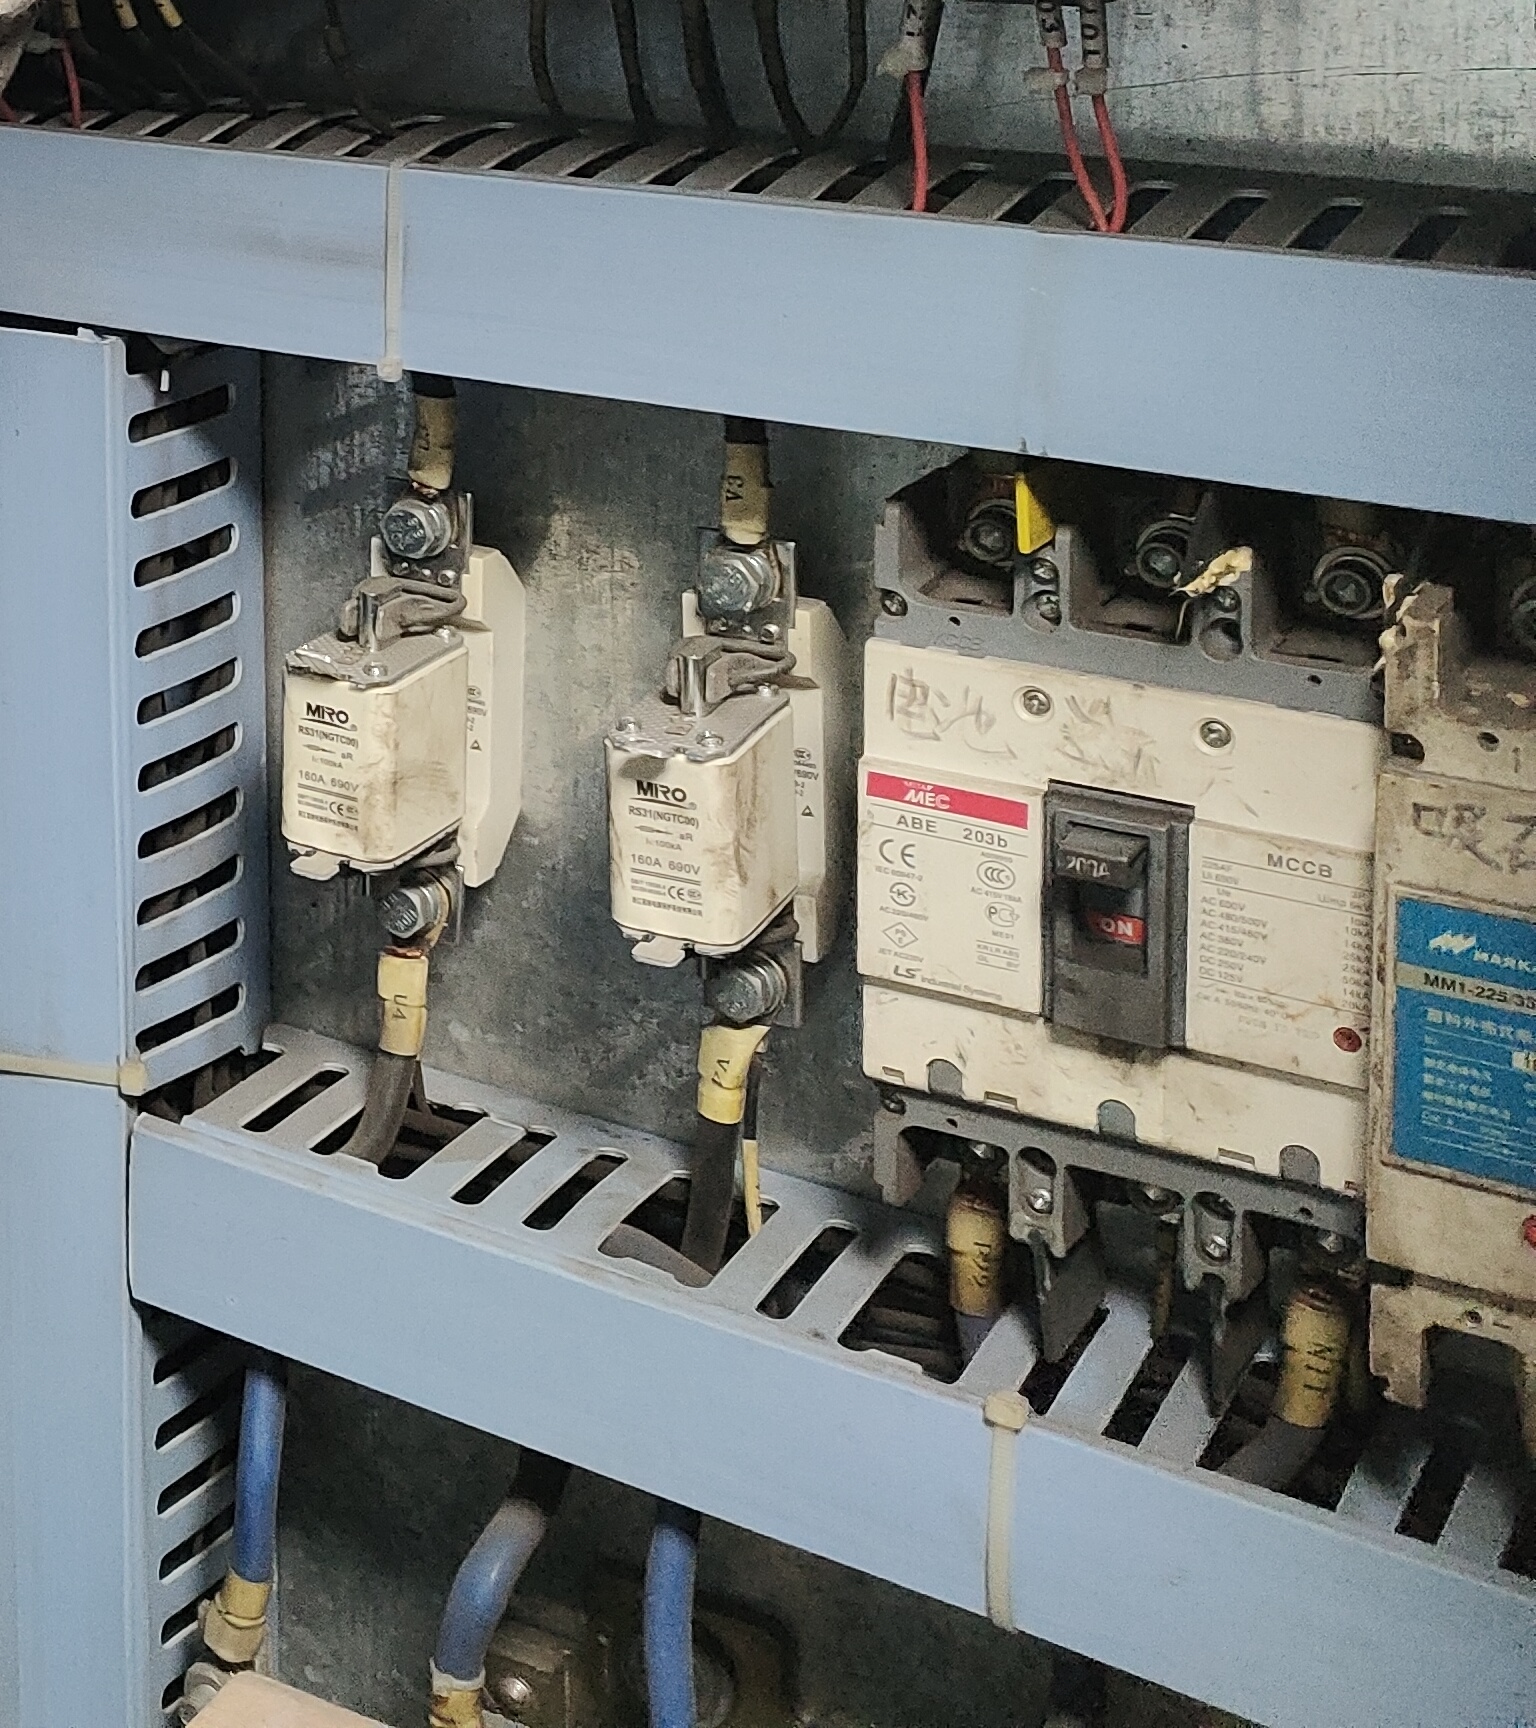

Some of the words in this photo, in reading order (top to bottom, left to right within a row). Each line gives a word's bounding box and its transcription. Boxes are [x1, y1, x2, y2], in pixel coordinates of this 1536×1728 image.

[306, 702, 349, 725] MIRO
[330, 776, 360, 793] 690V
[636, 779, 687, 804] MIRO
[903, 789, 951, 810] MEC
[896, 814, 939, 834] ABE
[962, 828, 1008, 849] 203b
[630, 853, 663, 869] 160A
[668, 860, 701, 875] 690V
[1267, 852, 1333, 879] MCCB
[1101, 917, 1133, 936] ON
[893, 964, 922, 980] LS
